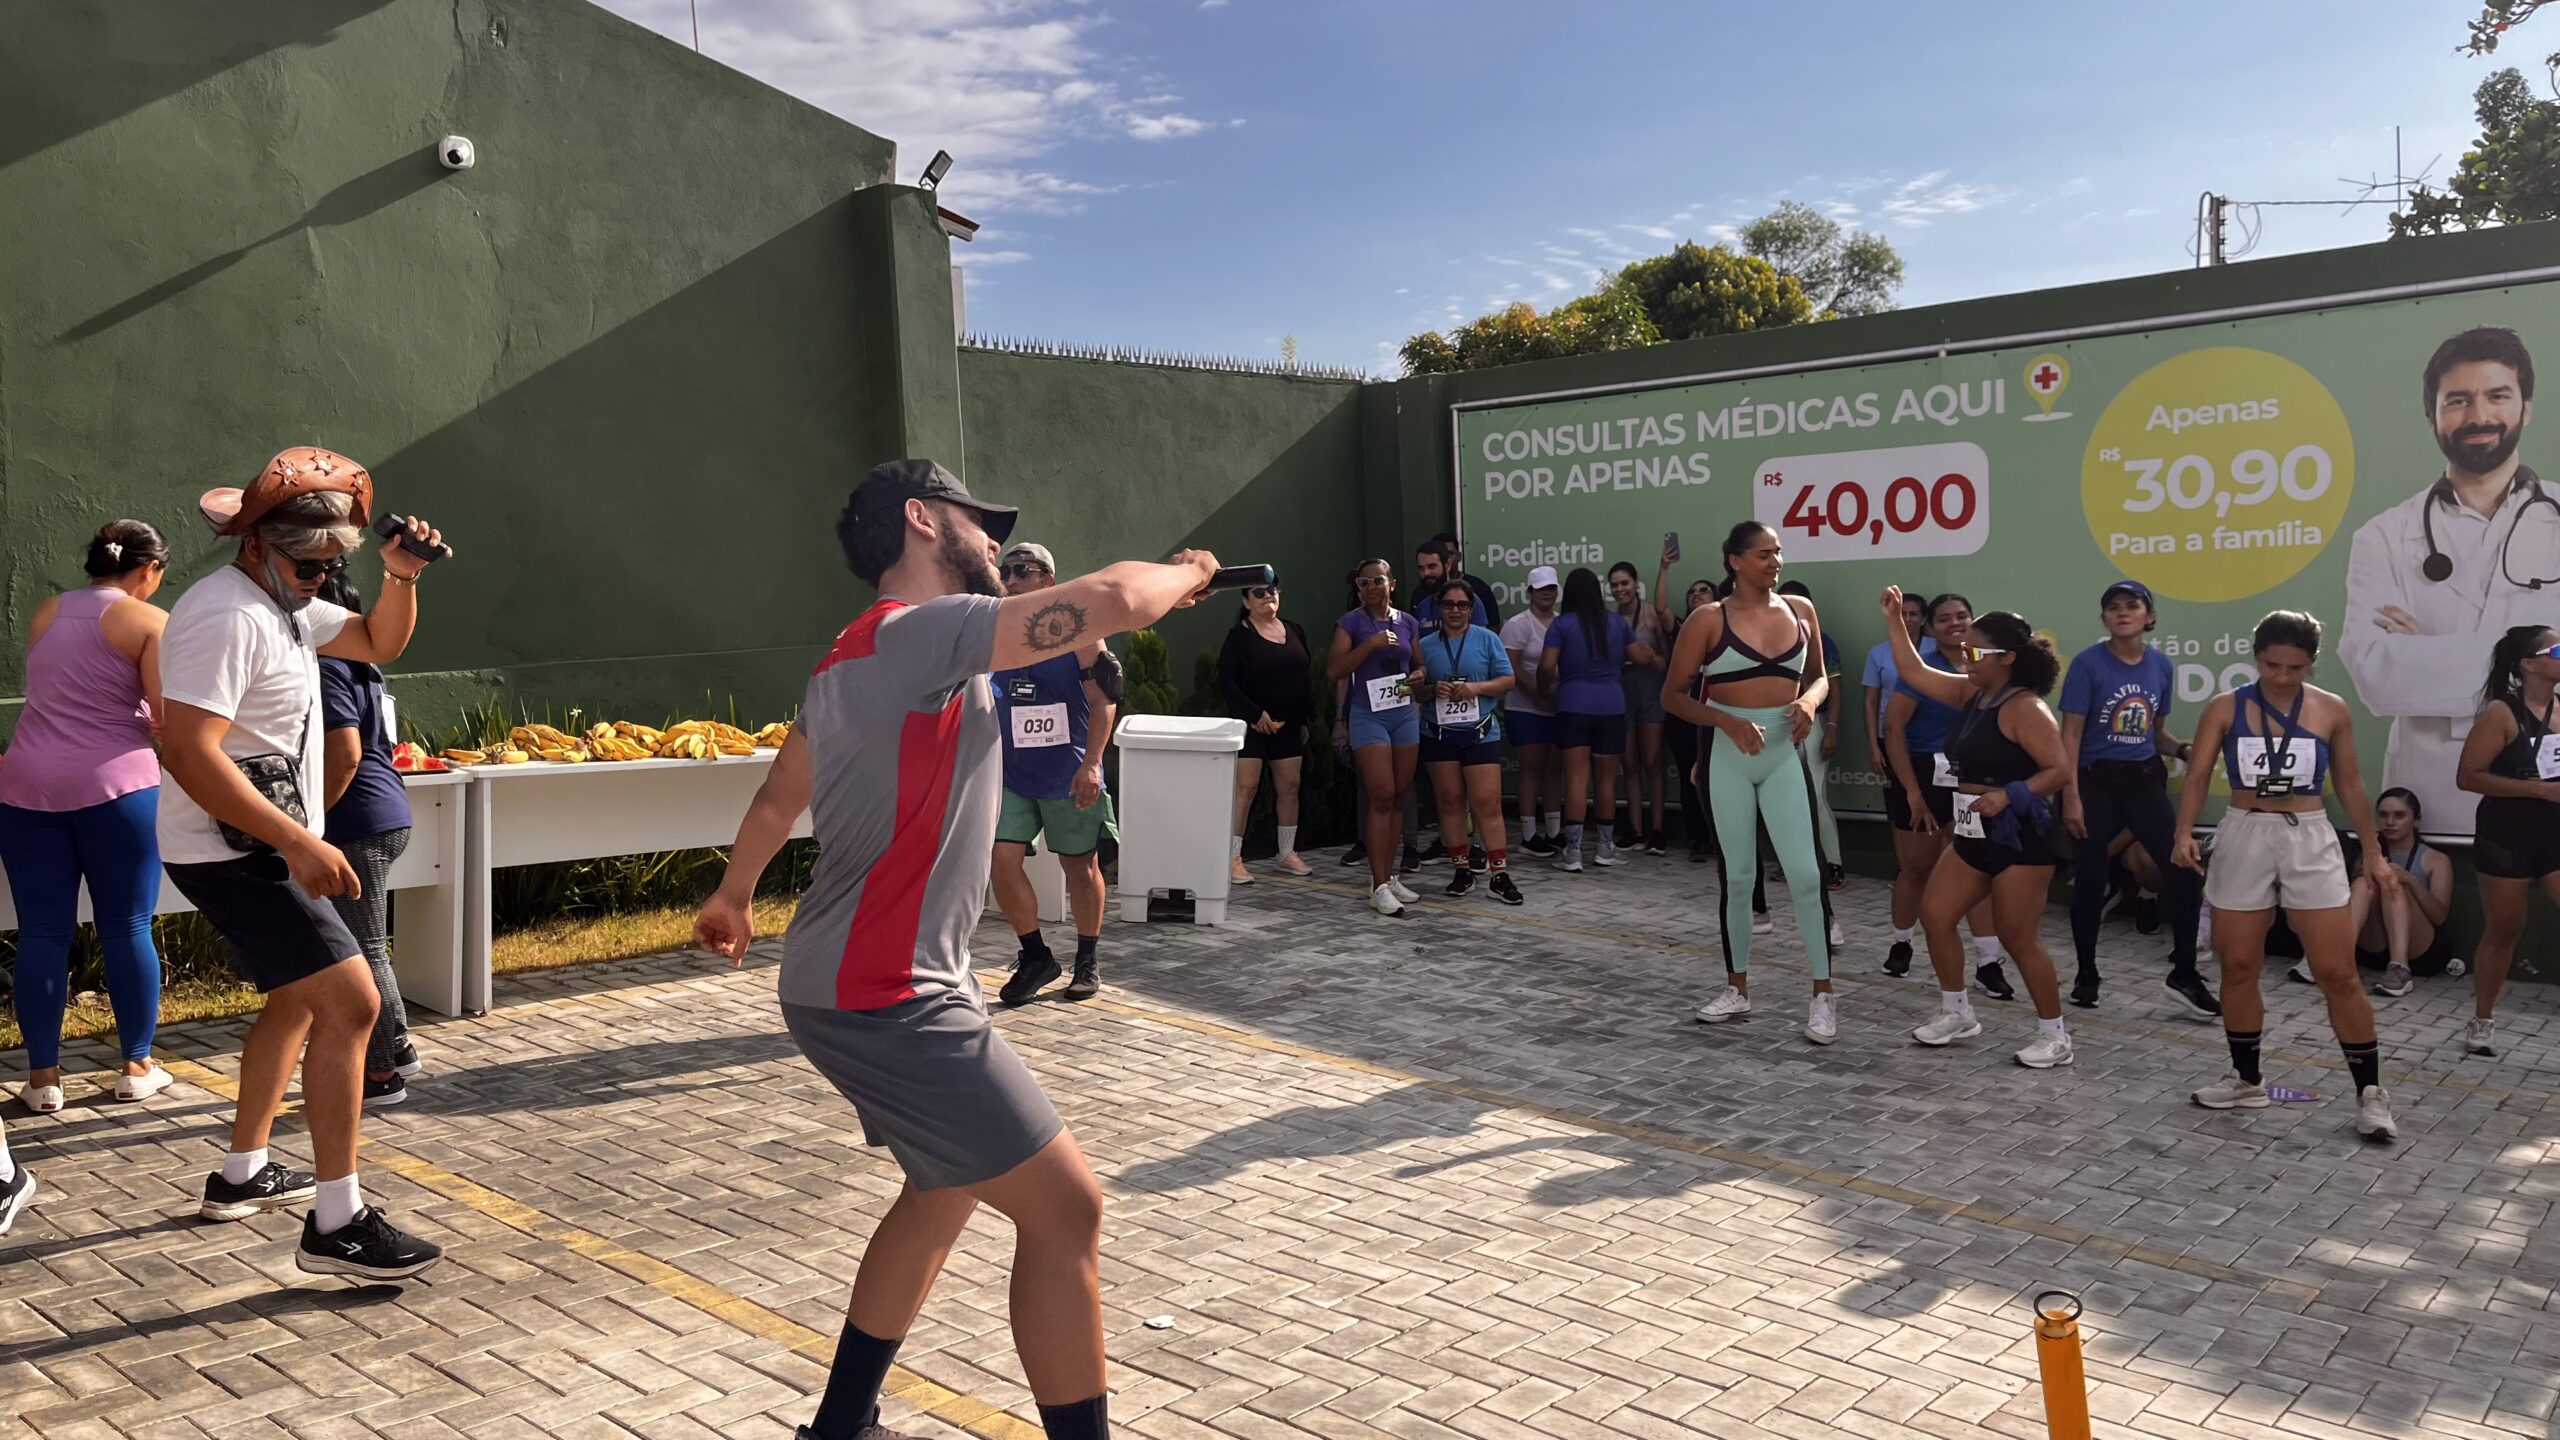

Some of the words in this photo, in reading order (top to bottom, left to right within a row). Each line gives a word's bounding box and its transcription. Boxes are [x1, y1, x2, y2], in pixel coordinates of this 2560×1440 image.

[1482, 411, 1685, 463] CONSULTAS
[1697, 396, 1880, 443] MÉDICAS
[1891, 378, 2007, 428] AQUI
[2145, 398, 2279, 434] Apenas
[1484, 467, 1554, 500] POR
[1563, 452, 1711, 495] APENAS
[2099, 447, 2121, 463] R$
[2122, 444, 2333, 518] 30,90
[1763, 471, 1783, 487] R$
[1782, 472, 1976, 546] 40,00
[2110, 533, 2176, 555] Para
[2185, 531, 2204, 549] a
[2212, 521, 2323, 550] família
[2214, 633, 2251, 656] de
[1379, 685, 1401, 700] 730
[1445, 702, 1468, 715] 220
[1024, 718, 1054, 734] 030
[2253, 753, 2297, 770] 40
